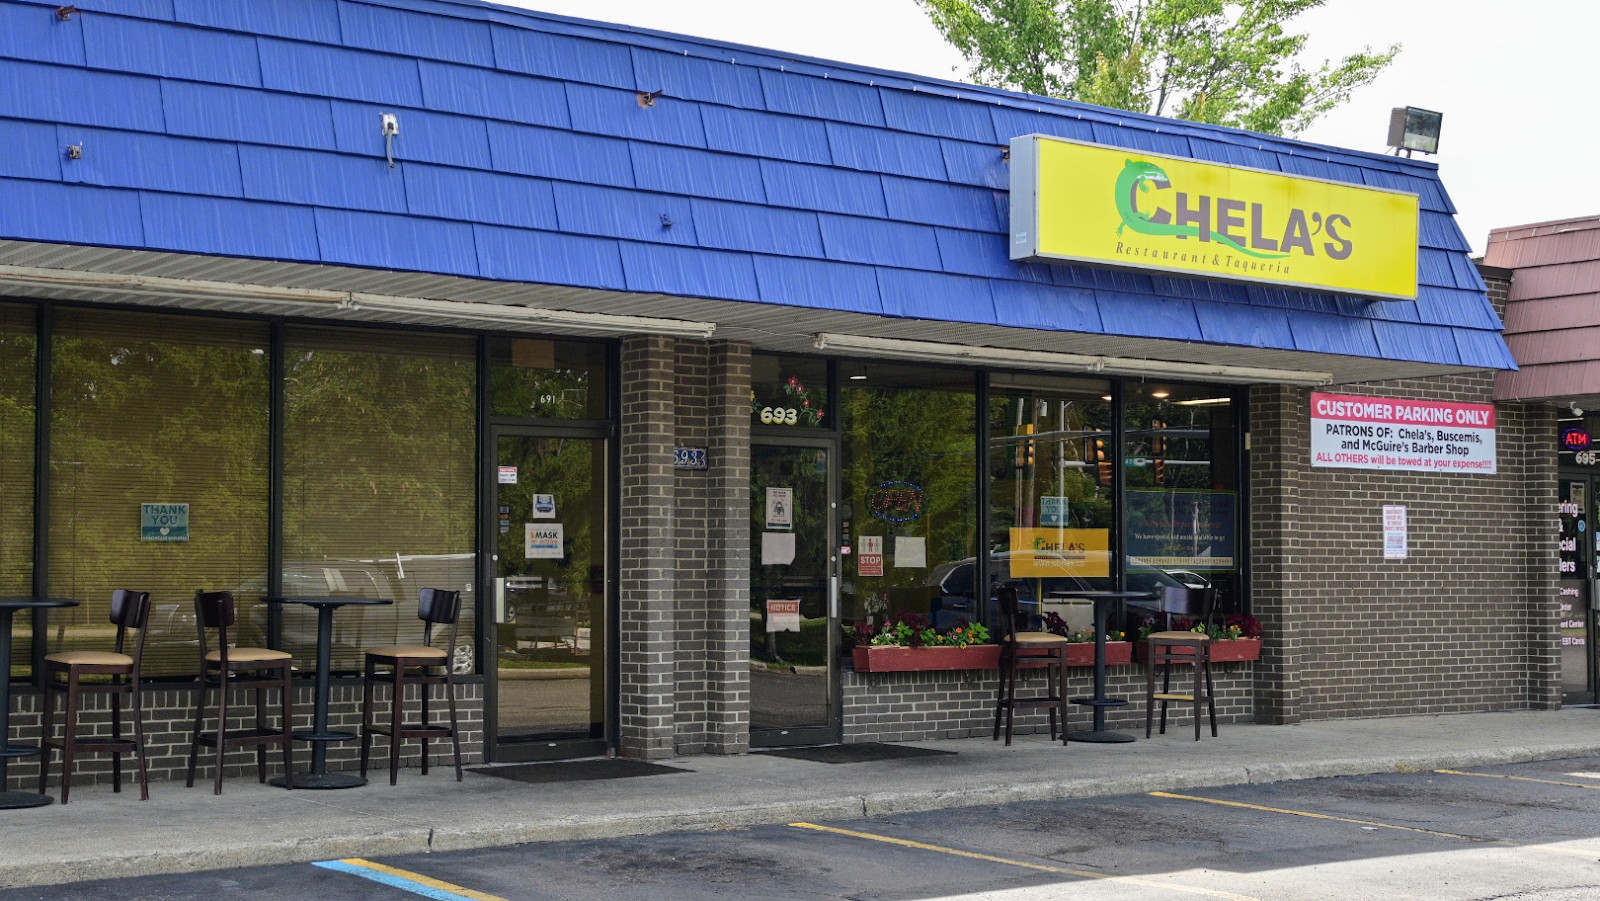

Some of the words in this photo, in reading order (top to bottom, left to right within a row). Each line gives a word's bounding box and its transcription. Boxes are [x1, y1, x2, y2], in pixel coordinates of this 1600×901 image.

[1116, 162, 1353, 260] CHELA'S
[1116, 241, 1207, 264] Restaurant
[1212, 253, 1220, 266] &
[1226, 255, 1290, 274] Taqueria
[540, 394, 555, 404] 691
[760, 406, 798, 425] 693
[1317, 399, 1393, 420] CUSTOMER
[1395, 404, 1453, 424] PARKING
[1455, 408, 1490, 426] ONLY
[1326, 423, 1374, 437] PATRONS
[1376, 426, 1393, 439] OF:
[1398, 428, 1435, 443] Chela's,
[1437, 430, 1483, 446] Buscemis,
[1565, 432, 1588, 446] ATM
[1341, 438, 1360, 450] and
[1362, 439, 1409, 453] McGuire's
[1412, 442, 1443, 454] Barber
[1445, 443, 1469, 457] Shop
[1316, 451, 1333, 462] ALL
[1334, 452, 1369, 464] OTHERS
[1371, 453, 1385, 465] will
[1386, 454, 1396, 465] be
[1397, 456, 1422, 467] towed
[1424, 458, 1432, 467] at
[1434, 460, 1451, 469] your
[1575, 451, 1596, 466] 695
[143, 504, 186, 514] THANK
[152, 515, 177, 525] YOU
[860, 556, 881, 564] STOP
[771, 604, 796, 612] NOTICE
